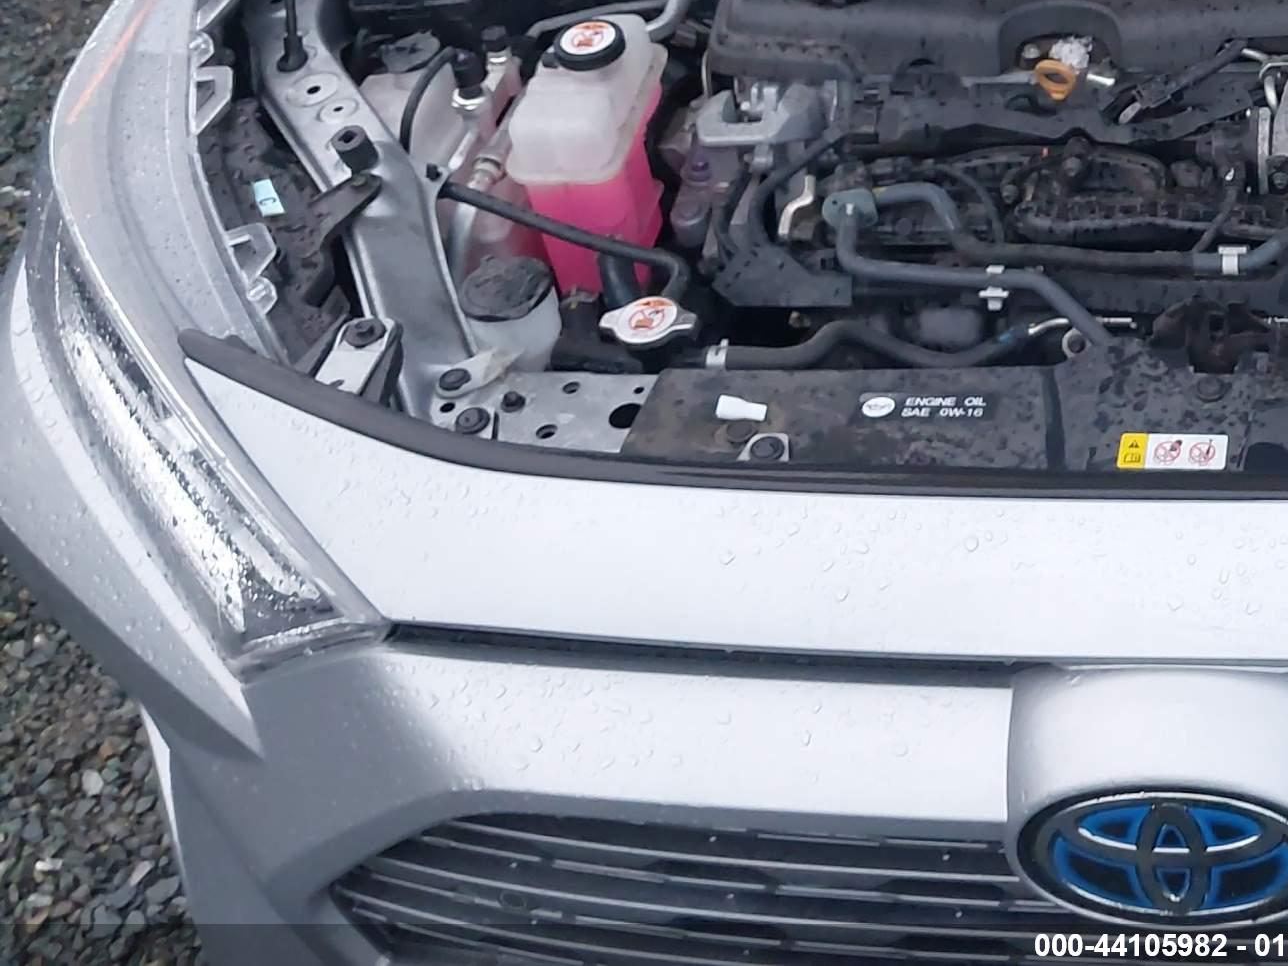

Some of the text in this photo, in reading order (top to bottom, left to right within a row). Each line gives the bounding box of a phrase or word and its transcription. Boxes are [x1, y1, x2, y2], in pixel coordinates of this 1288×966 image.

[905, 397, 987, 407] ENGINE OIL
[901, 407, 984, 417] SAE 0W-16
